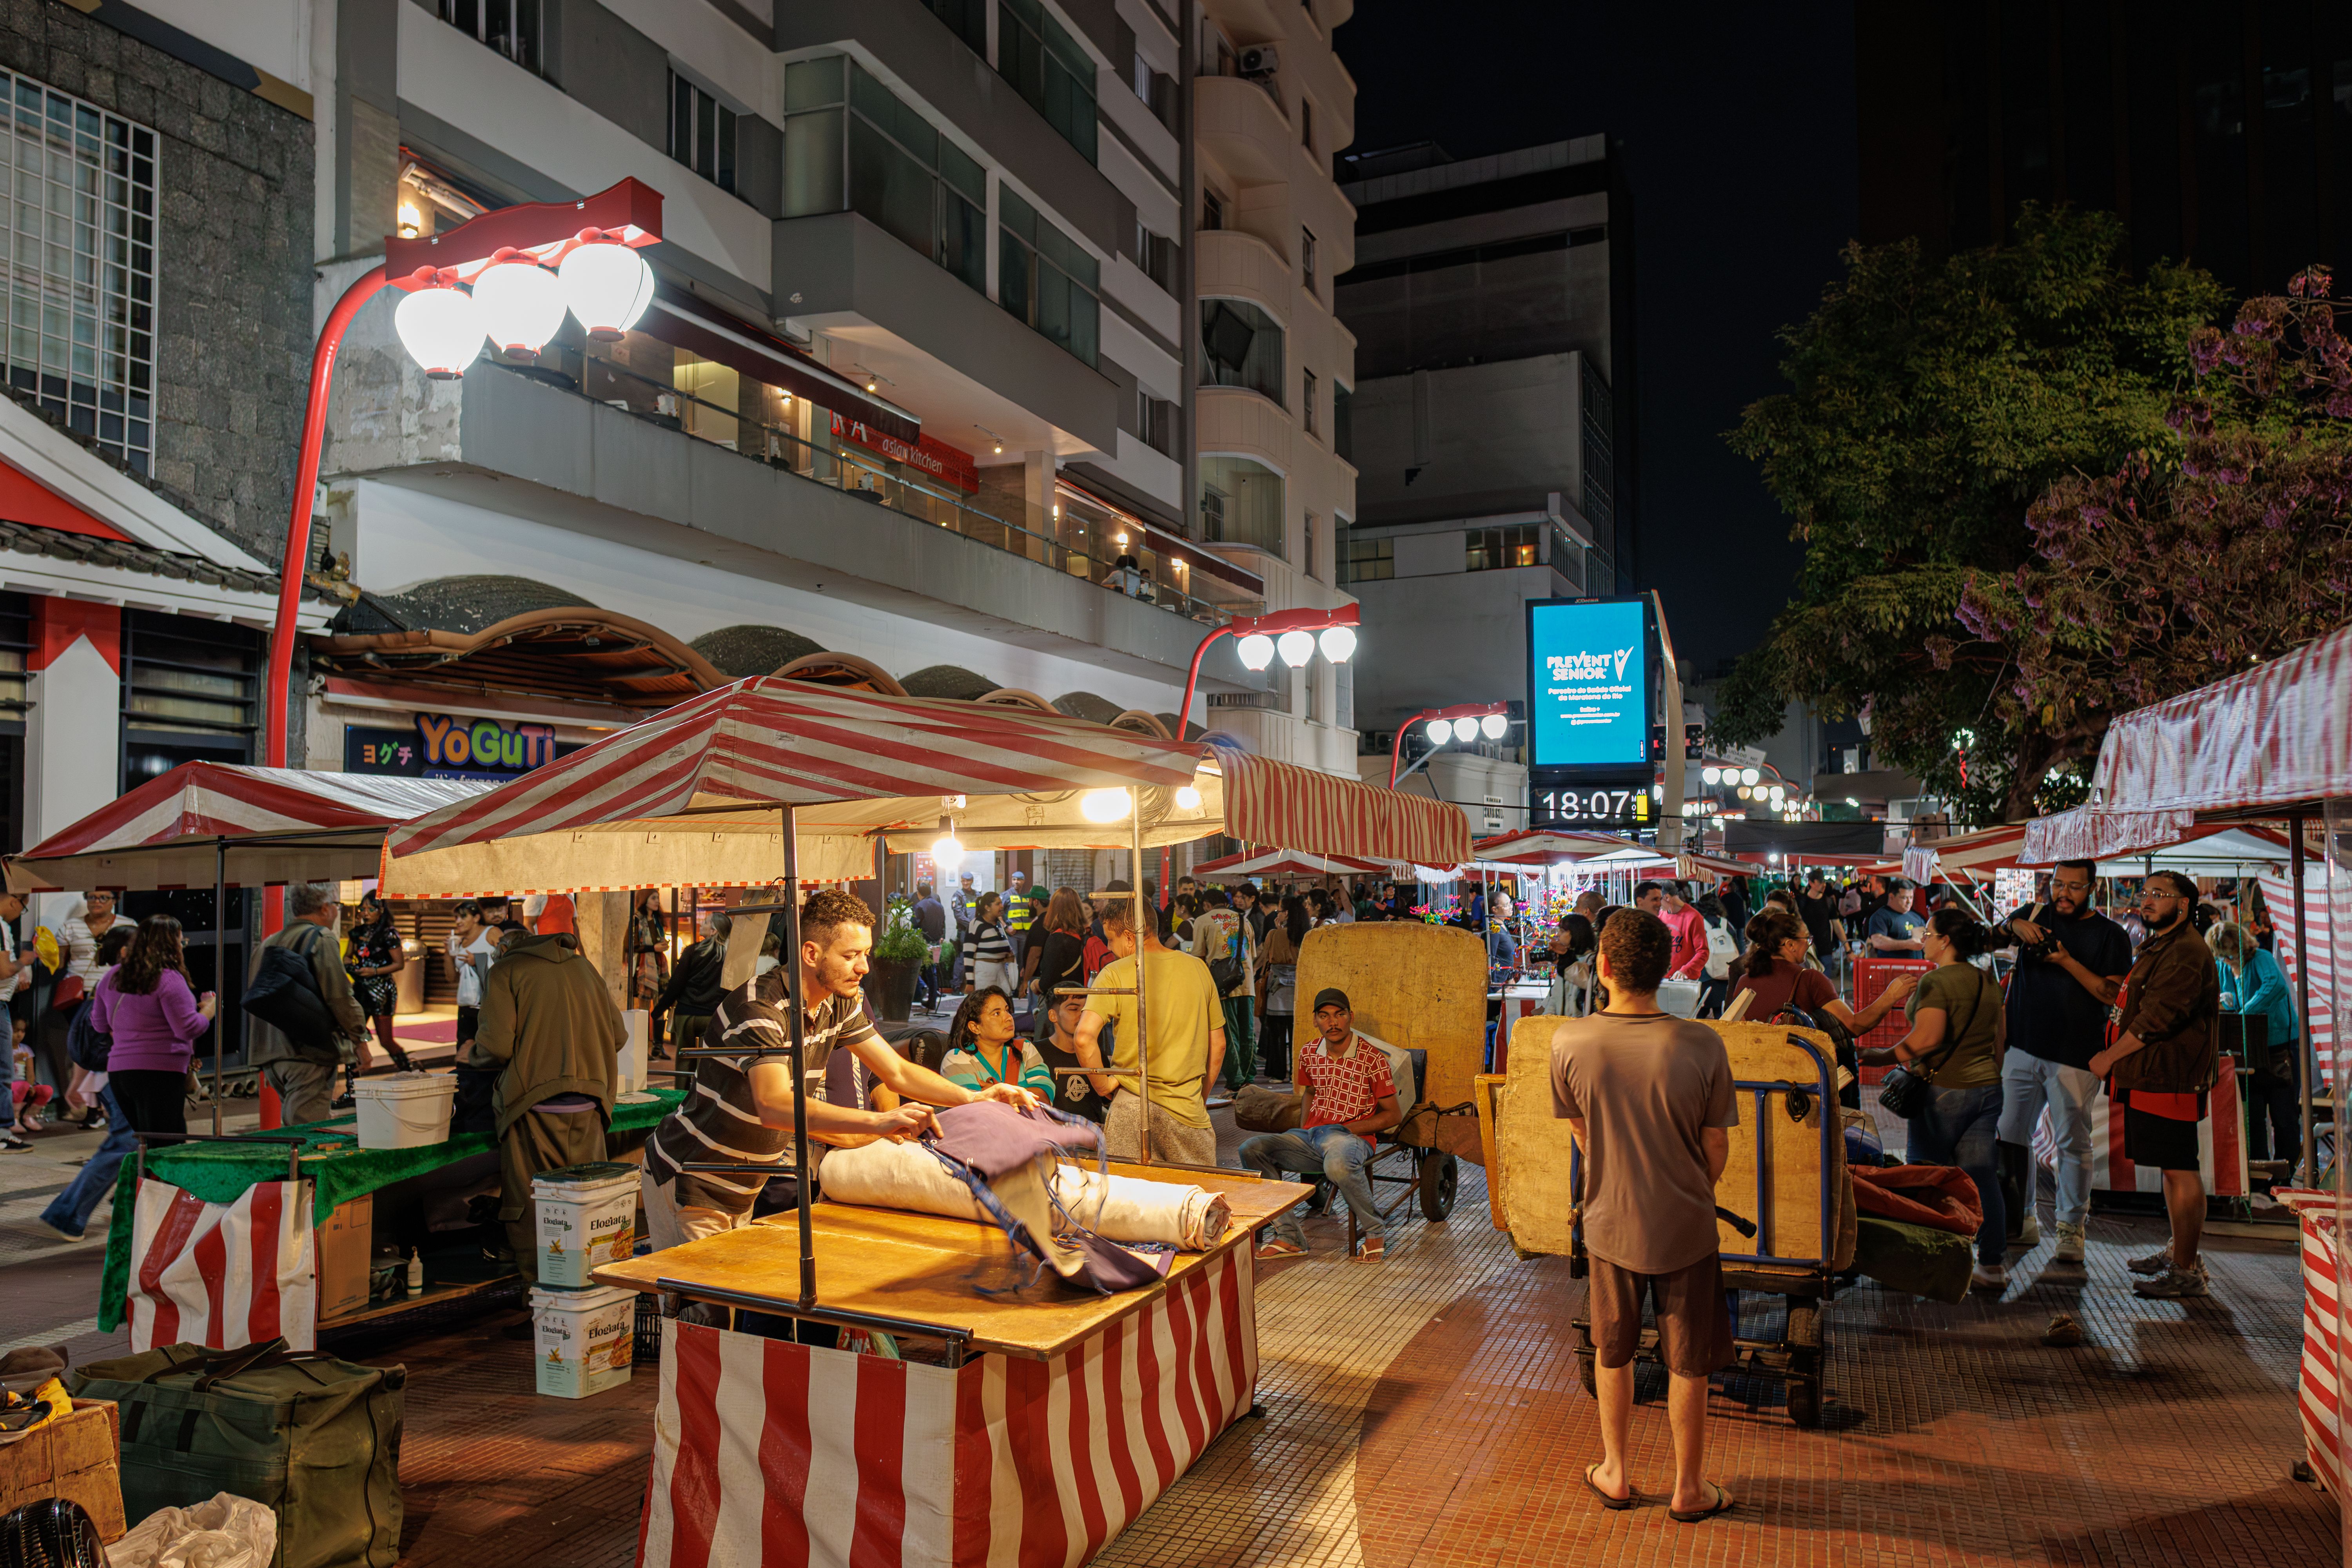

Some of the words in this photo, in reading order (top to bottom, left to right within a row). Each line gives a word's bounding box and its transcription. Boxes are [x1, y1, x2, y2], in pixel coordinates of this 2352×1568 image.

[882, 439, 908, 460] asian
[911, 446, 943, 474] kitchen
[1547, 650, 1612, 669] PREVENT
[1553, 667, 1606, 681] SENIOR
[363, 740, 412, 766] ヨグチ
[1543, 791, 1630, 820] 18:07
[543, 1217, 568, 1227] Elogiata
[590, 1215, 626, 1230] Elogiata
[543, 1325, 566, 1336] Elogiata
[589, 1321, 625, 1339] Elogiata
